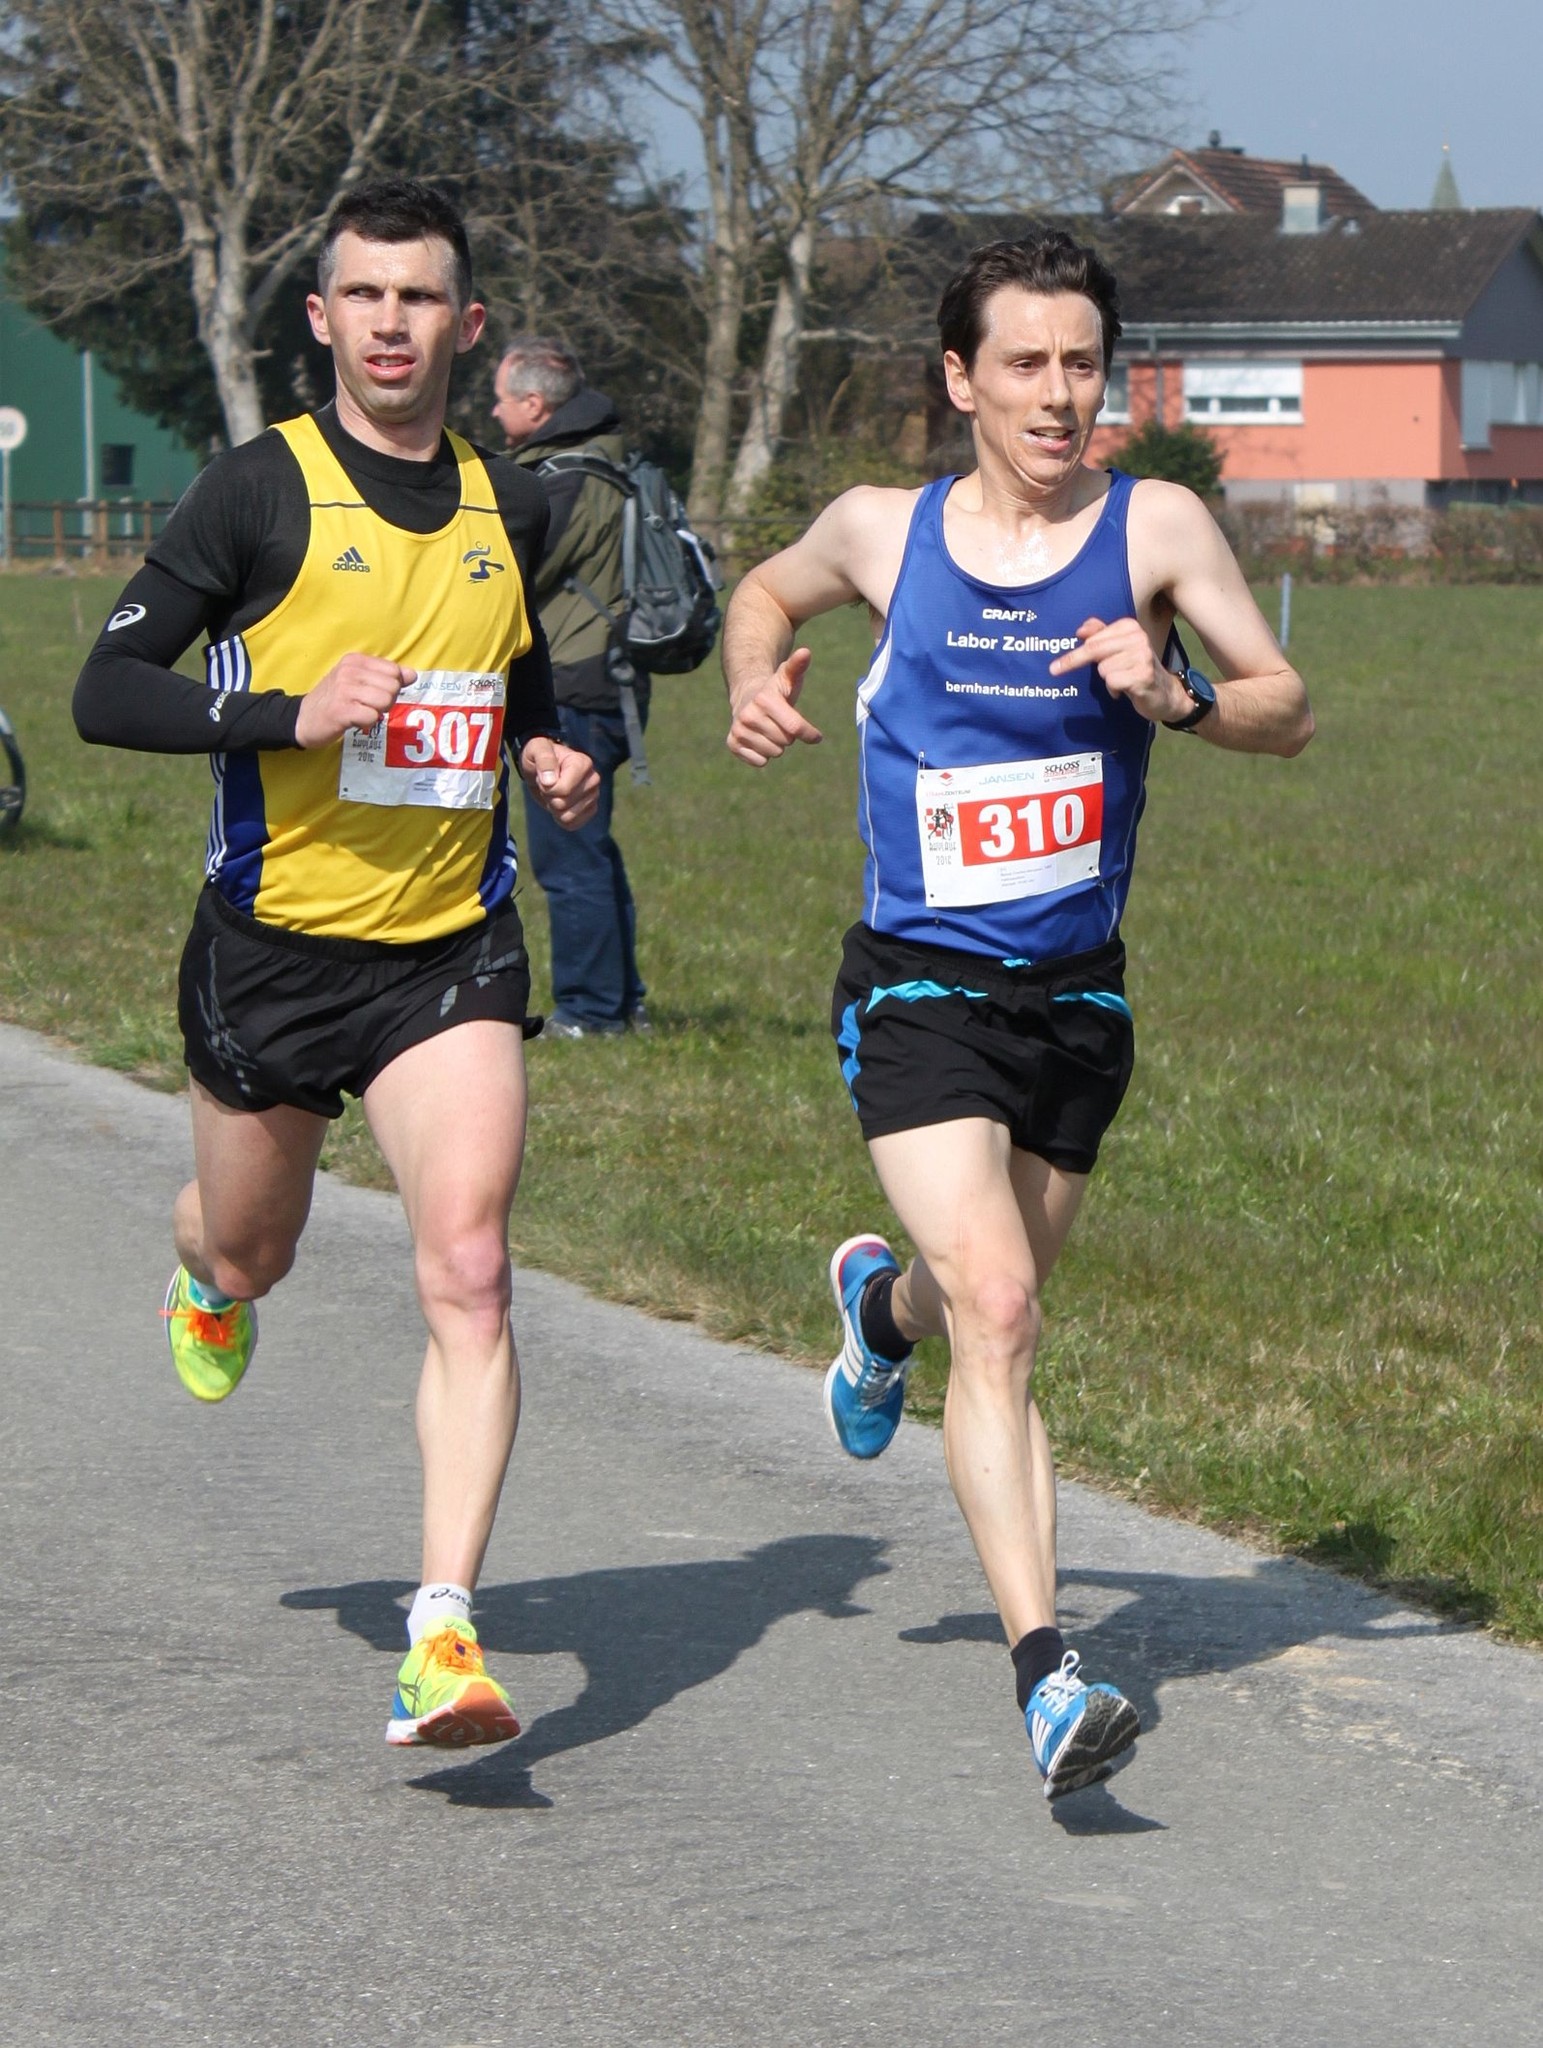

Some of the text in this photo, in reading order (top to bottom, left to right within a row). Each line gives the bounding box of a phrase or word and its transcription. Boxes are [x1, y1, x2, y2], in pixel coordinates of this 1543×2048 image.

[332, 561, 371, 573] adidas
[982, 608, 1027, 622] CRAFT
[946, 630, 1078, 654] Labor Zollinger
[413, 681, 461, 692] JANSEN
[945, 680, 1078, 700] bernhart-laufshop.ch
[404, 708, 494, 764] 307
[1044, 760, 1081, 774] SCHLOSS
[978, 772, 1035, 786] JANSEN
[978, 794, 1085, 858] 310
